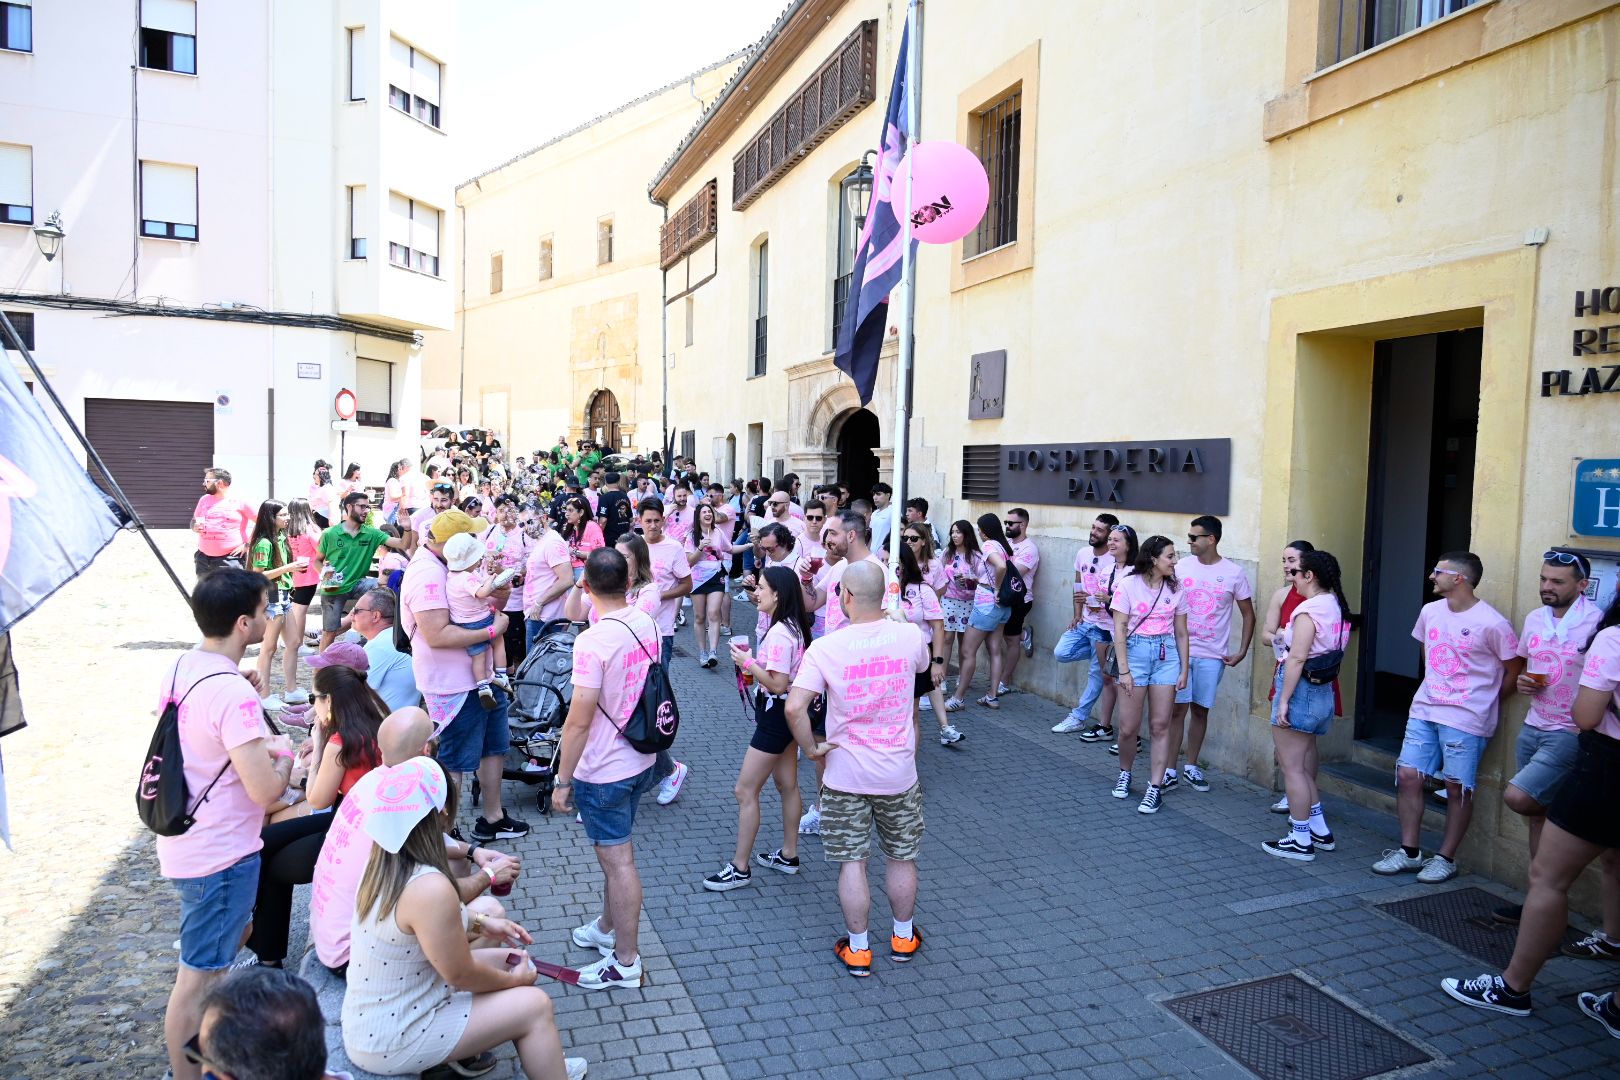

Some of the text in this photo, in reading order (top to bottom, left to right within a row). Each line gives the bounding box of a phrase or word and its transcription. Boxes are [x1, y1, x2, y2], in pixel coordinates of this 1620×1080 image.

[1572, 324, 1620, 357] RE
[1541, 364, 1620, 398] PLAZ
[1007, 447, 1207, 473] HOSPEDERIA
[1068, 477, 1126, 503] PAX
[849, 658, 903, 680] NOX
